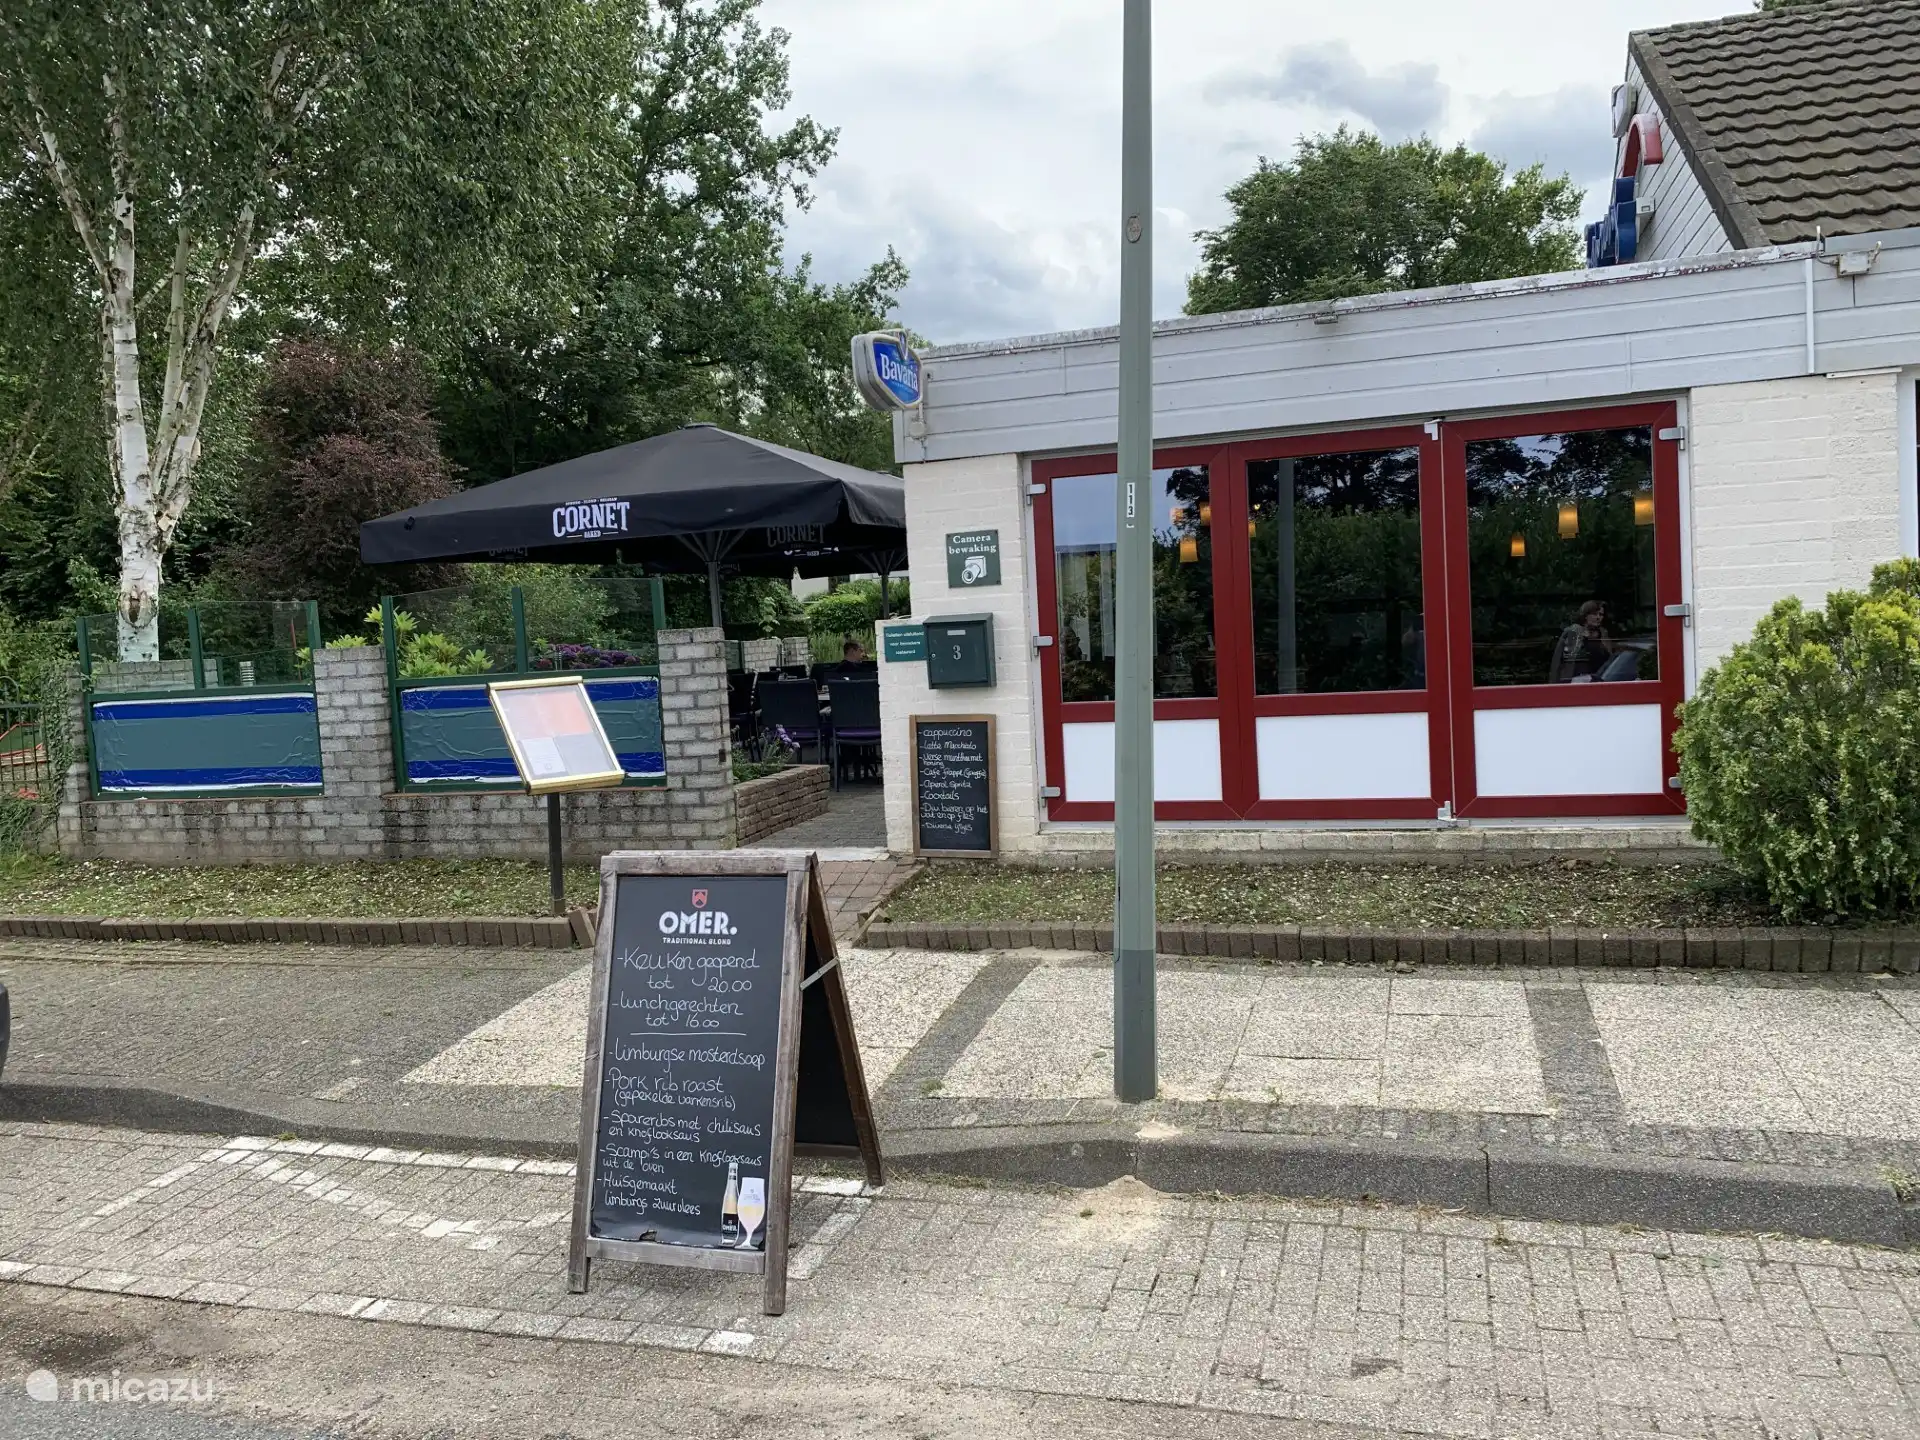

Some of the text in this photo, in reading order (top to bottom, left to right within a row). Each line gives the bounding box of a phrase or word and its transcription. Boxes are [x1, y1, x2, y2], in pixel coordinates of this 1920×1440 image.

[552, 501, 630, 538] CORNET
[952, 534, 992, 544] Camera
[948, 544, 997, 555] bewaking
[953, 644, 962, 660] 3
[662, 937, 707, 945] TRADITIONAL
[691, 948, 761, 987] geopend
[646, 974, 752, 993] tot 20.00
[645, 1012, 670, 1027] tot
[688, 1046, 766, 1071] mosterdsoep
[654, 1072, 679, 1092] rib
[682, 1075, 724, 1093] roast
[614, 1089, 736, 1111] (gepekelde varkensrib)
[608, 1126, 701, 1145] en knoflooksaus
[677, 1115, 702, 1130] met
[706, 1116, 761, 1137] chilisaus
[664, 1147, 675, 1161] in
[676, 1150, 695, 1163] een
[602, 1156, 665, 1174] uit de oven
